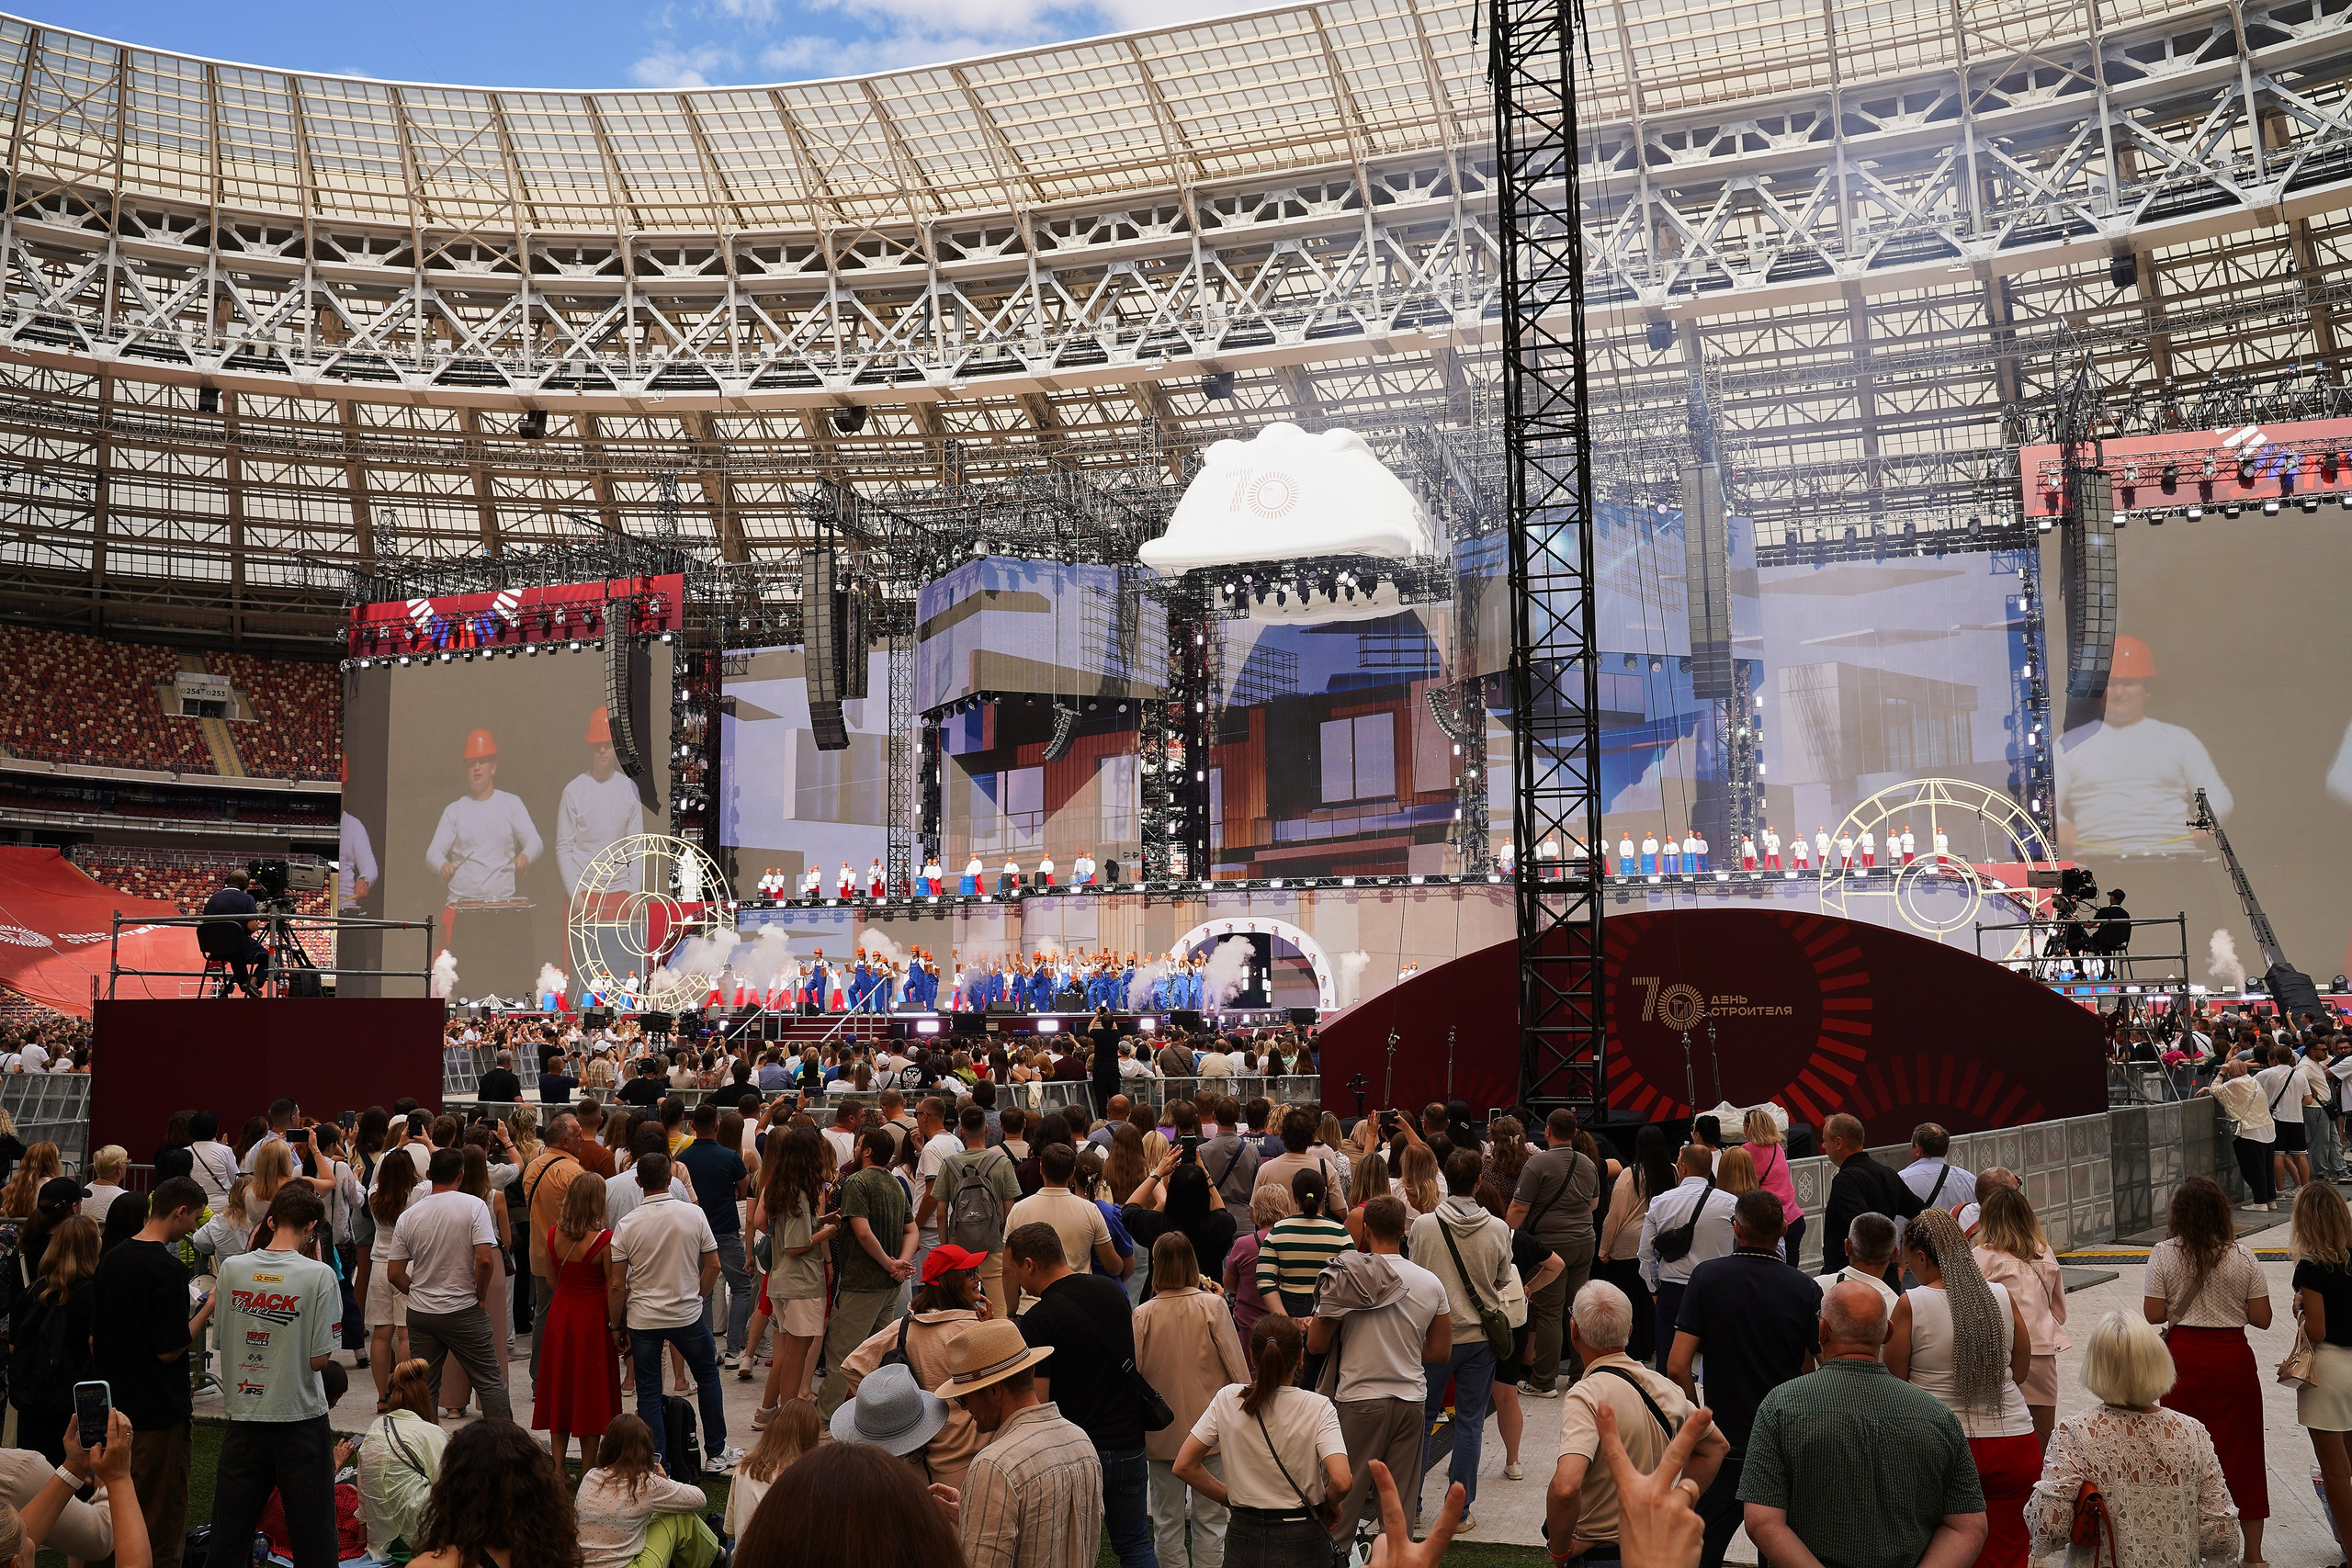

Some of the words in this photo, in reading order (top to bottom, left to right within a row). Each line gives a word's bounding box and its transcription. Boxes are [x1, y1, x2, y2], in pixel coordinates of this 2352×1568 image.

[1226, 467, 1299, 519] 70
[57, 931, 107, 940] ДЕНЬ
[1632, 976, 1705, 1032] 70
[1711, 995, 1748, 1005] ДЕНЬ
[1711, 1006, 1793, 1018] СТРОИТЕЛЯ
[232, 1290, 301, 1312] TRACK
[246, 1330, 271, 1340] 1991
